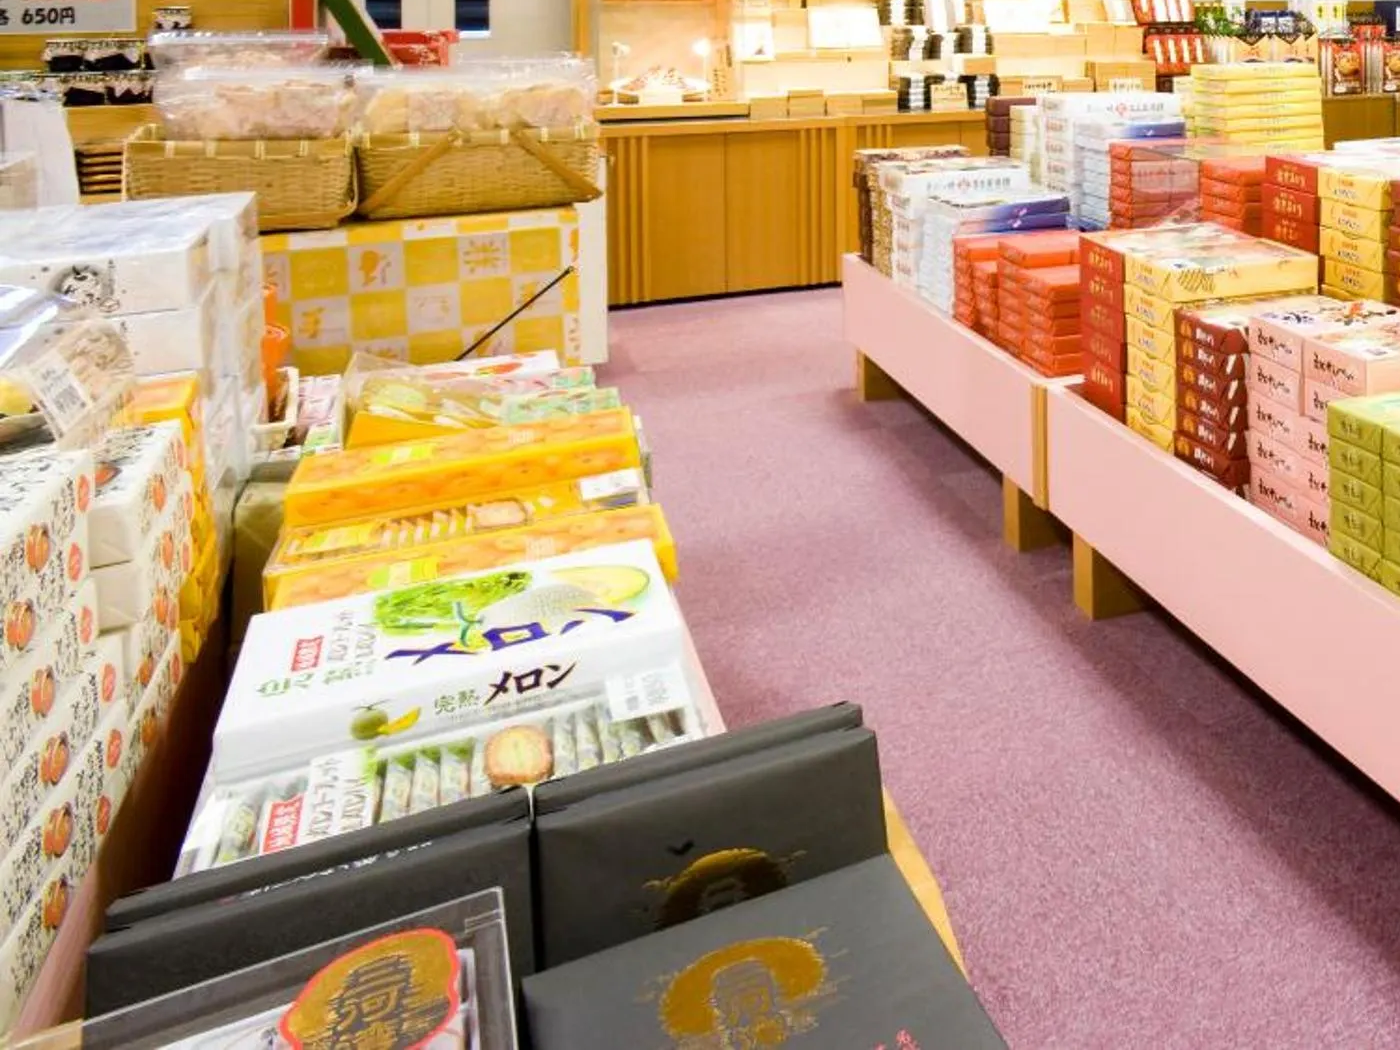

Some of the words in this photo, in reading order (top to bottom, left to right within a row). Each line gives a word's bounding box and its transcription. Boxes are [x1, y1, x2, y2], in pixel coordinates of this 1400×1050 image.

[22, 5, 76, 25] 650円
[483, 660, 577, 707] メロン
